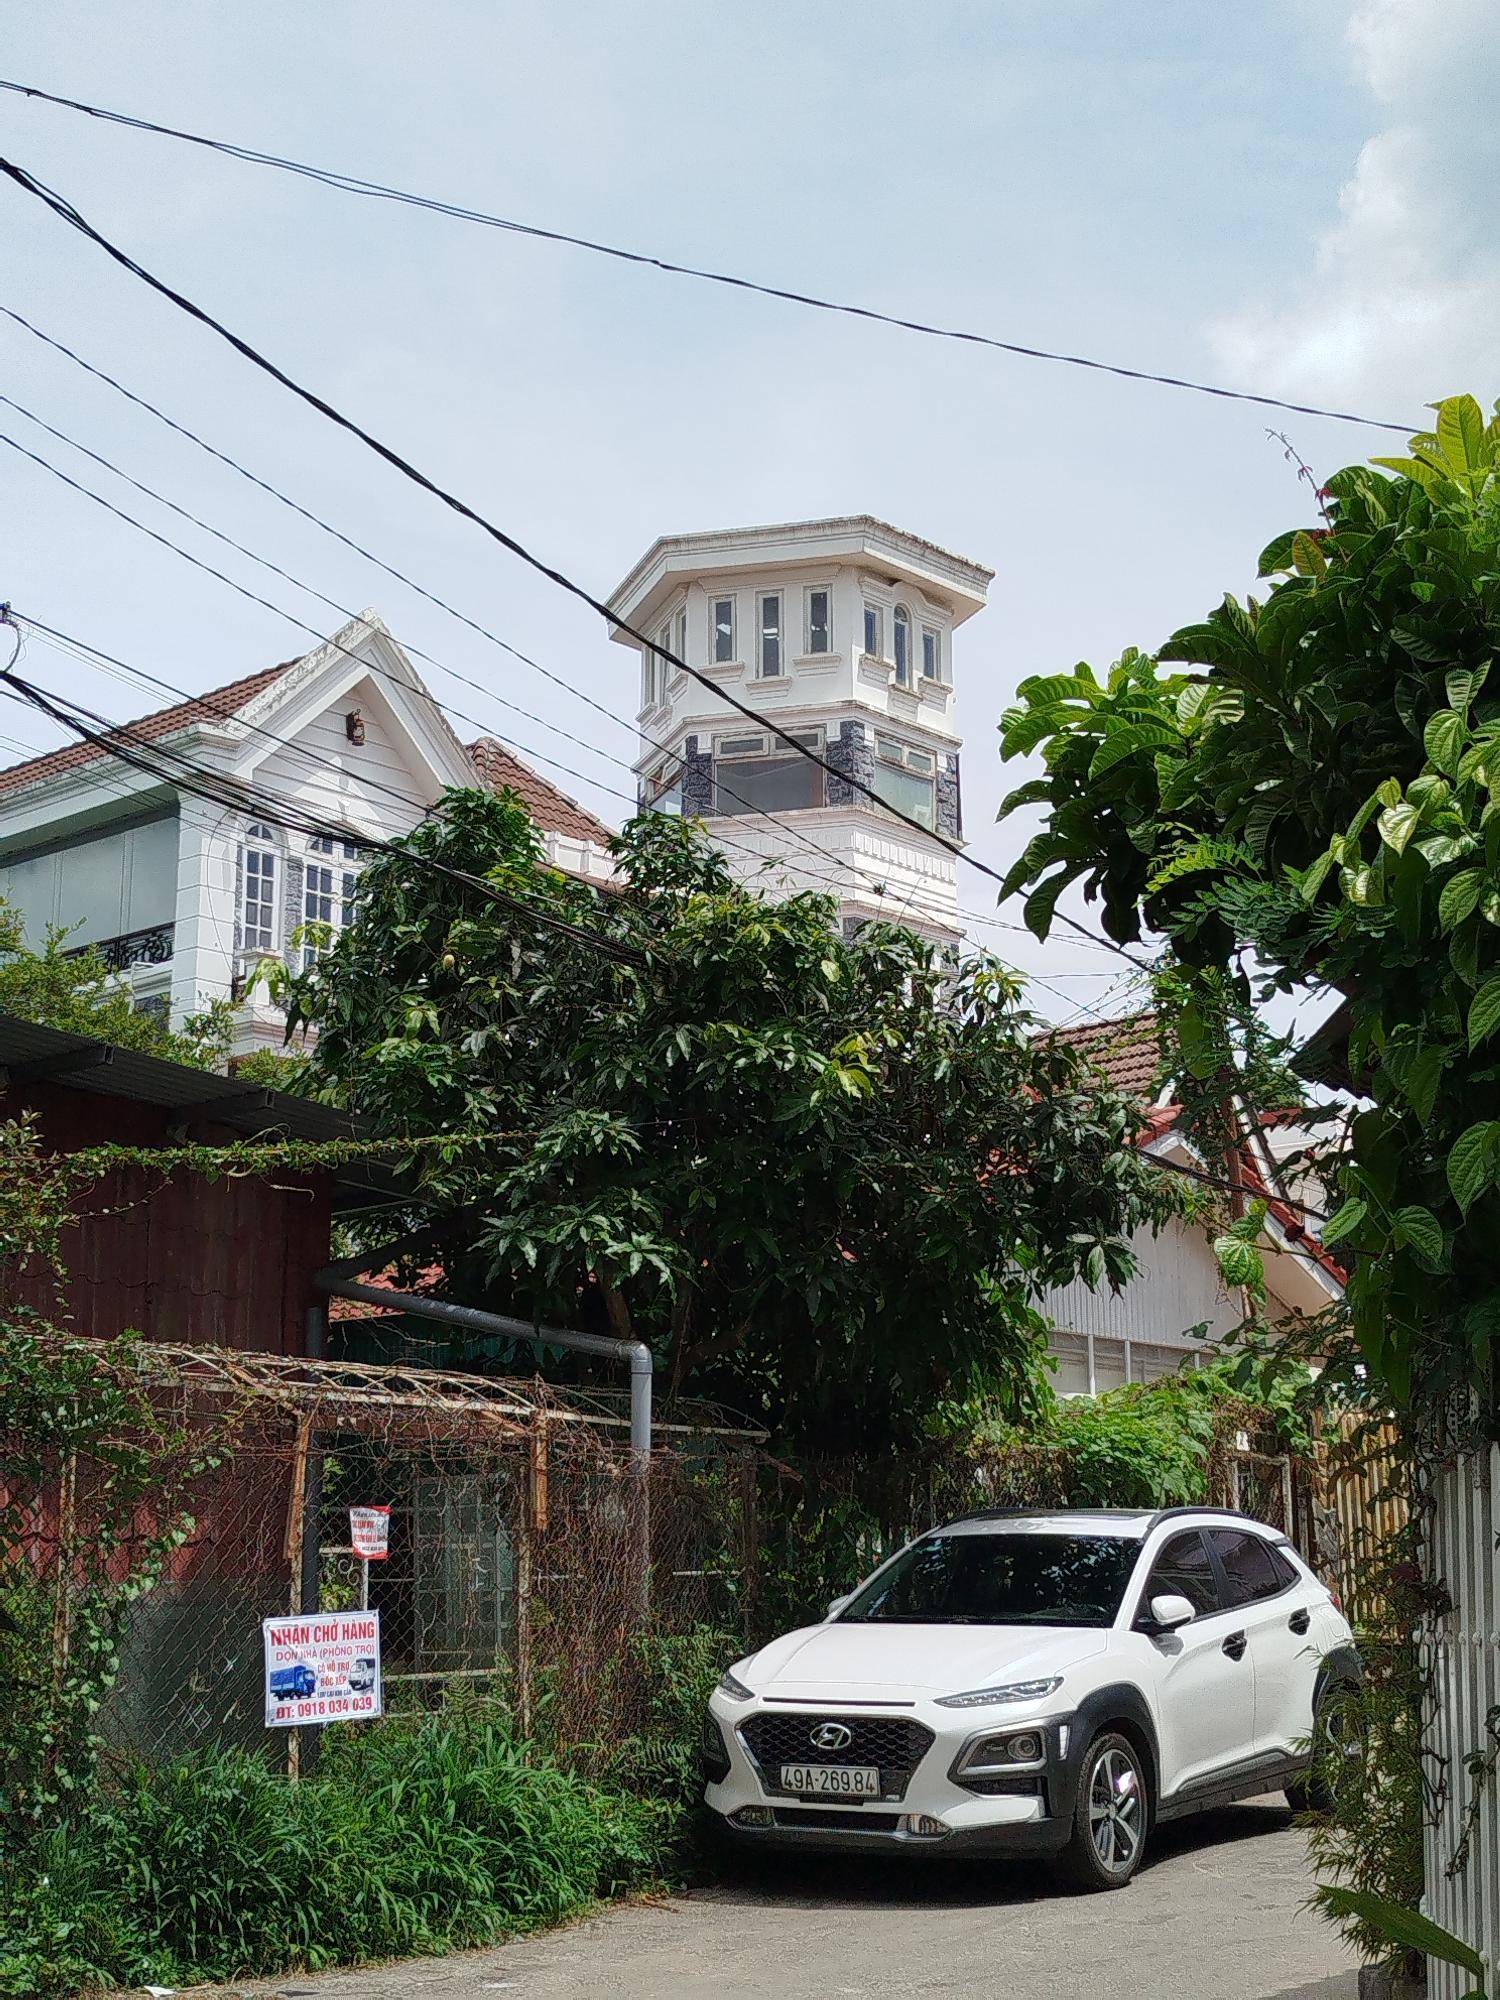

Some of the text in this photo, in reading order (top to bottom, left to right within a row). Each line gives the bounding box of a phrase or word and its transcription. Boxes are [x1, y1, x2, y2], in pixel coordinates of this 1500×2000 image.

[314, 1618, 339, 1643] CHỞ
[342, 1619, 375, 1641] HÀNG
[276, 1643, 375, 1663] DỌN NHÀ (PHÒNG TRỌ)
[277, 1697, 372, 1719] ĐT: 0918 034 039
[784, 1768, 875, 1793] 49A-269.84
